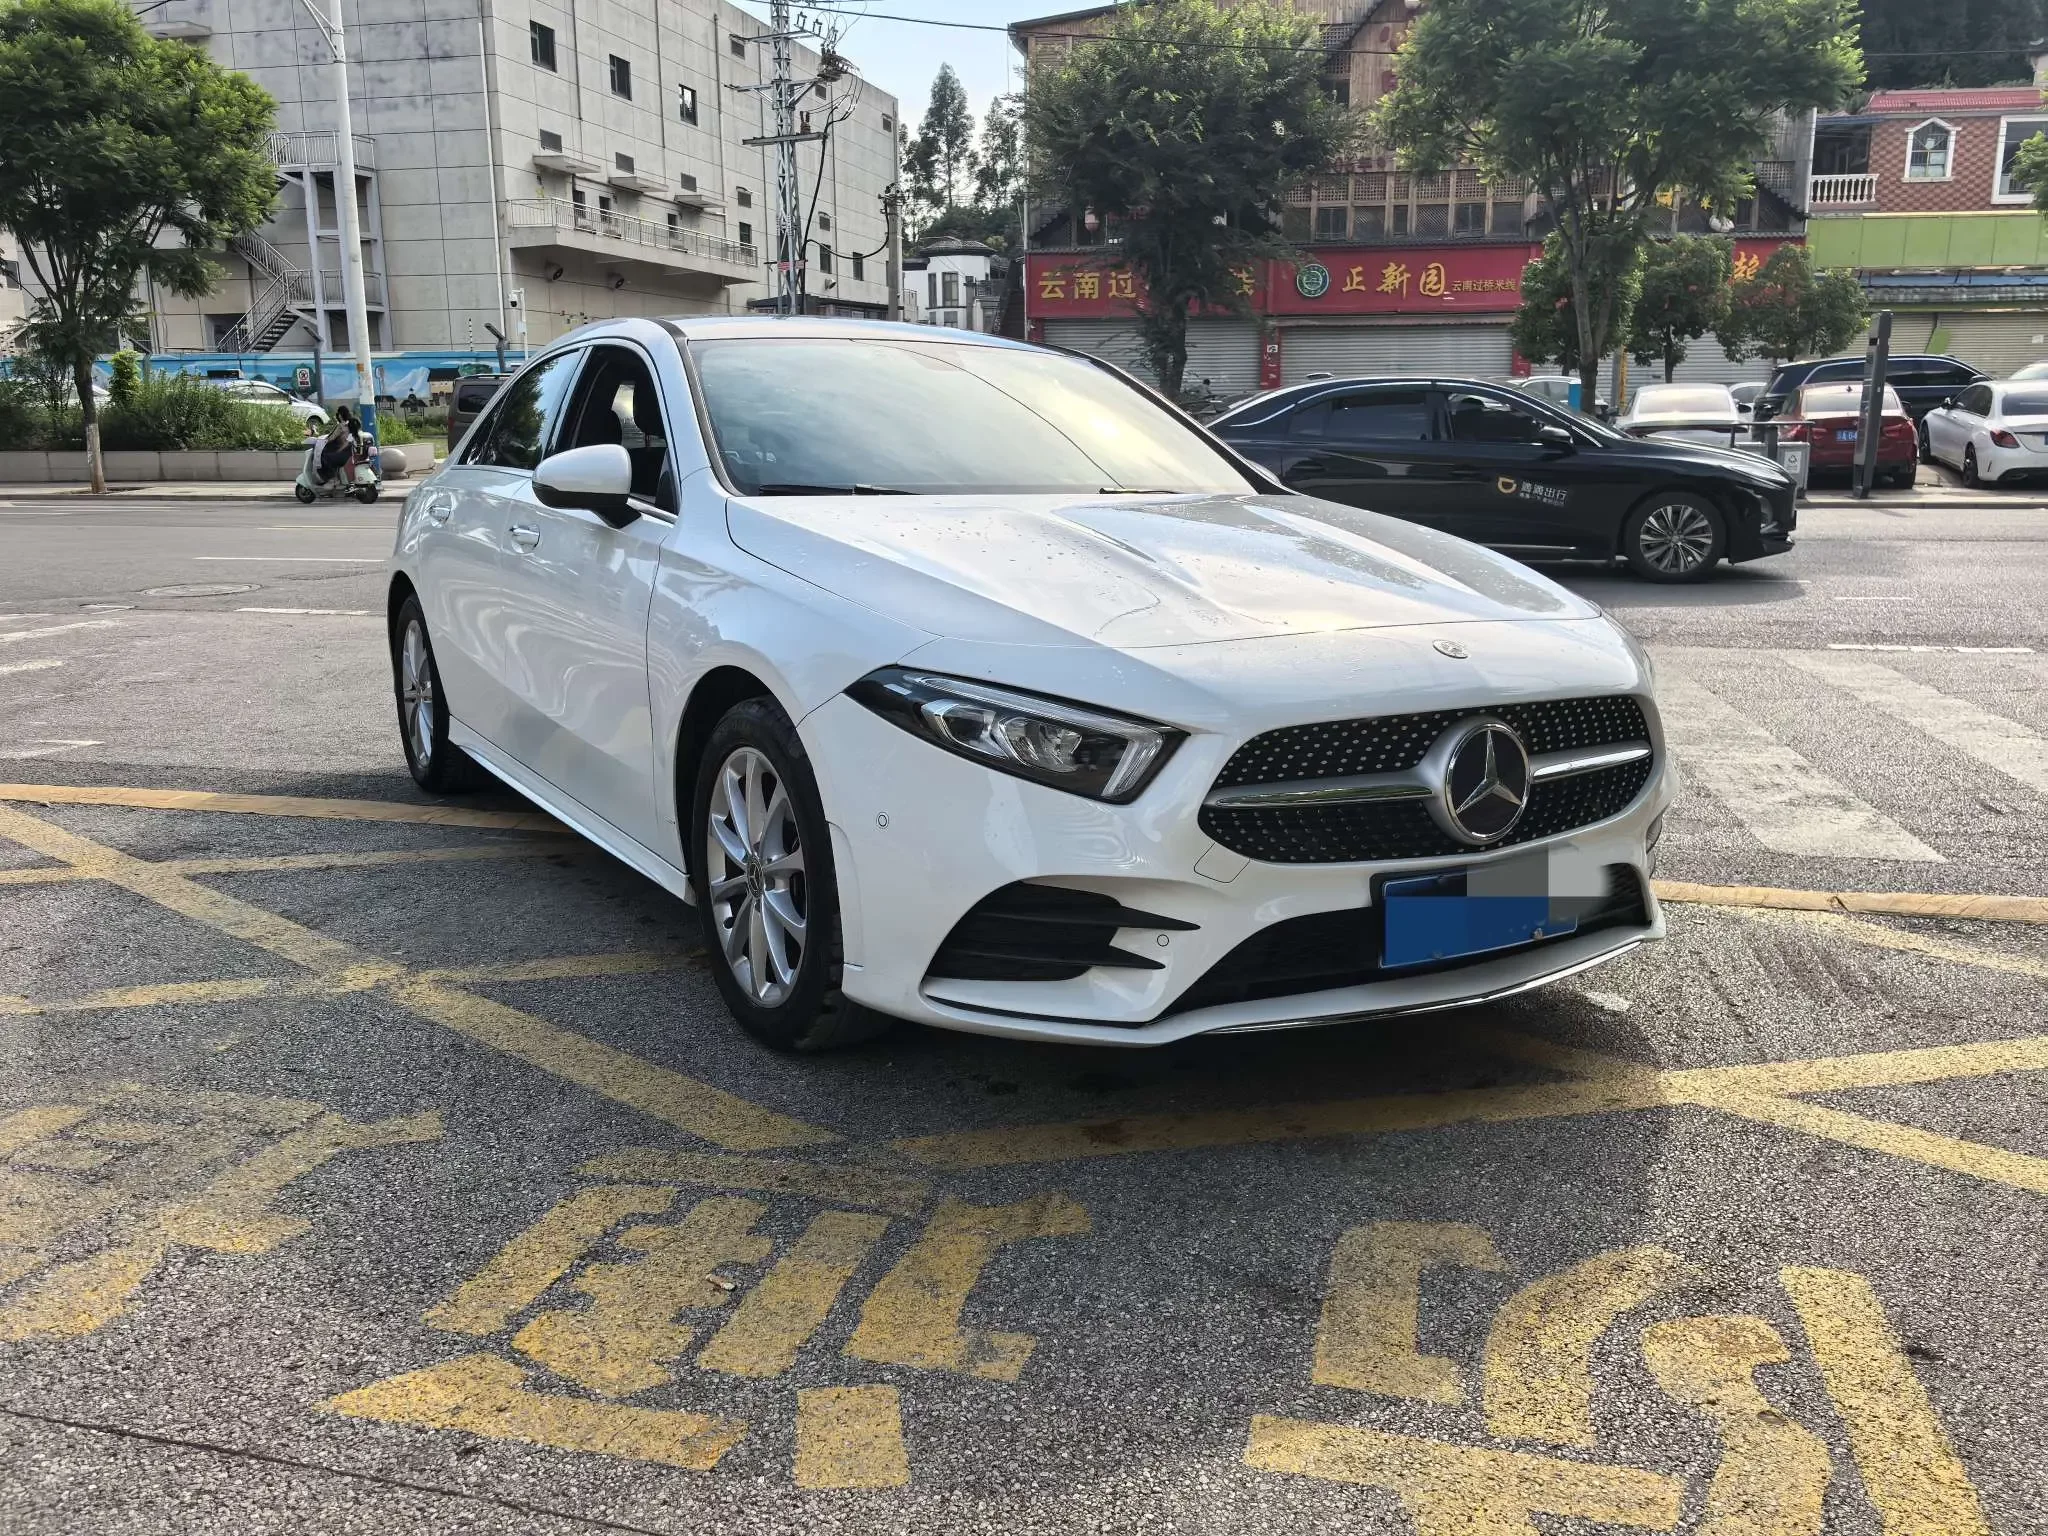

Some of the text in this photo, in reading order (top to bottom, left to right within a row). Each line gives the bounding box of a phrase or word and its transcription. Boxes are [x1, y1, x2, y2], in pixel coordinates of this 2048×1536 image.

[1342, 262, 1445, 300] 正新园
[1451, 278, 1517, 292] 云南过桥米线
